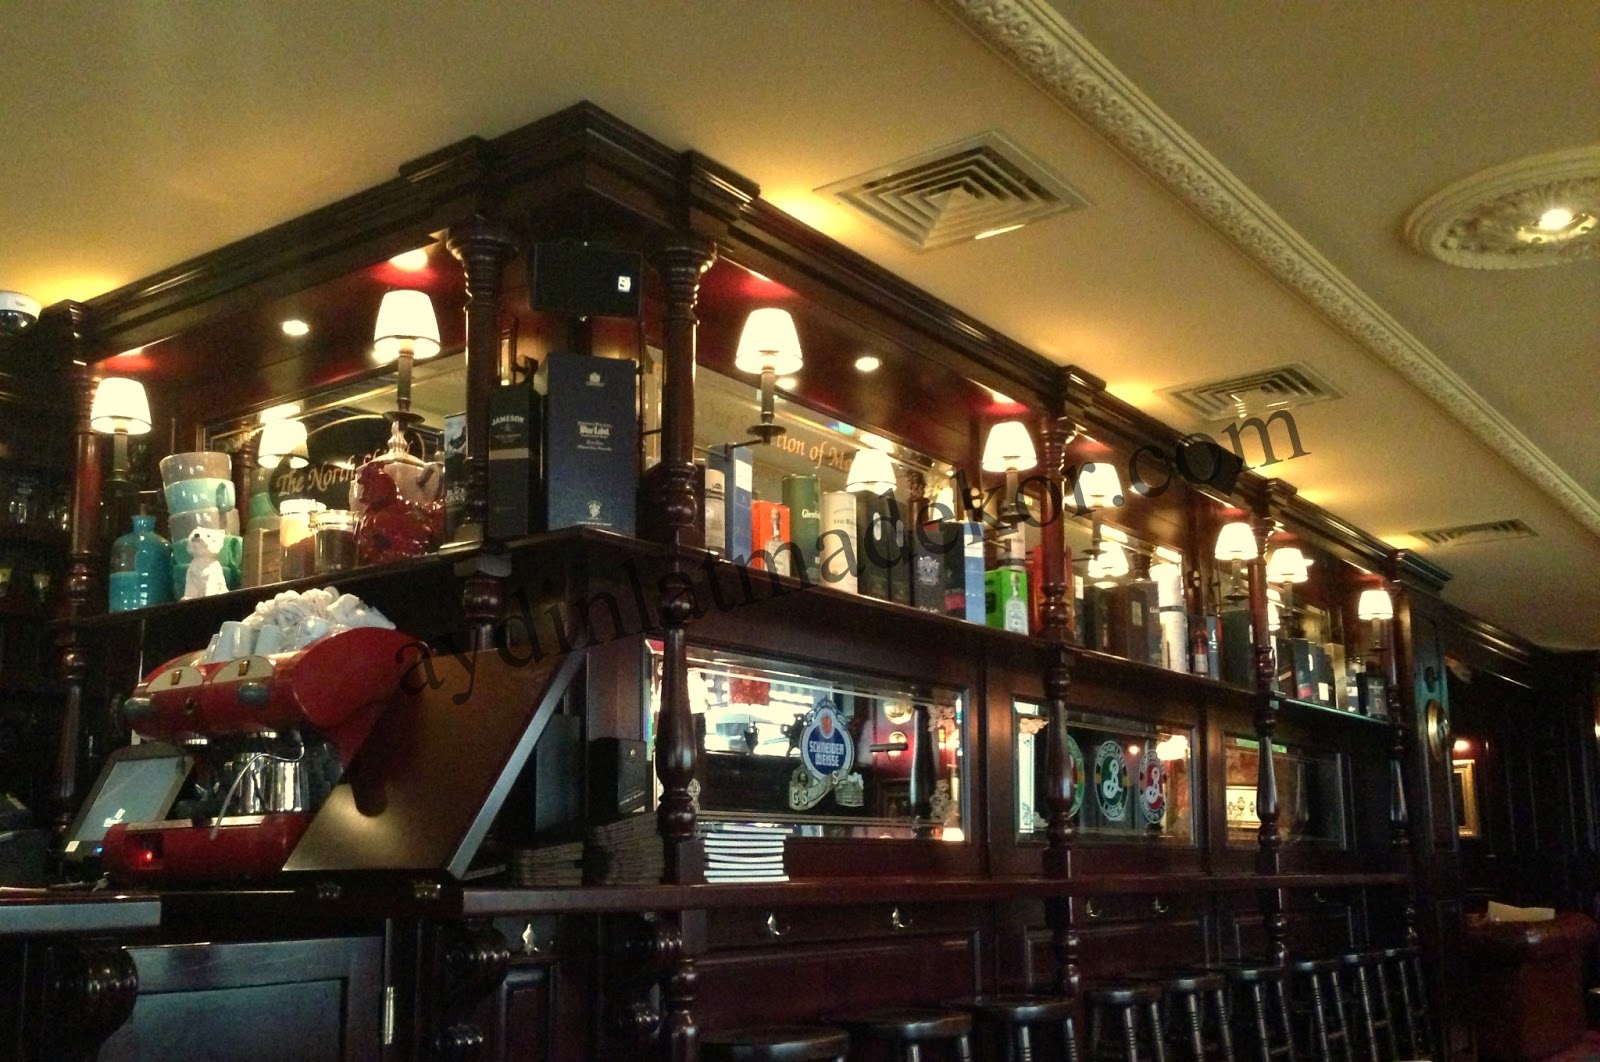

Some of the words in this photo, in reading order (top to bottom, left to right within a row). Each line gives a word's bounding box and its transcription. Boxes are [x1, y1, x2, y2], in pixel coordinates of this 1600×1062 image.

[491, 414, 525, 426] JAMESON
[809, 440, 828, 470] of
[276, 469, 304, 497] The
[306, 455, 357, 492] North
[809, 741, 846, 756] SCHNEIDER
[815, 753, 840, 768] WEISSE
